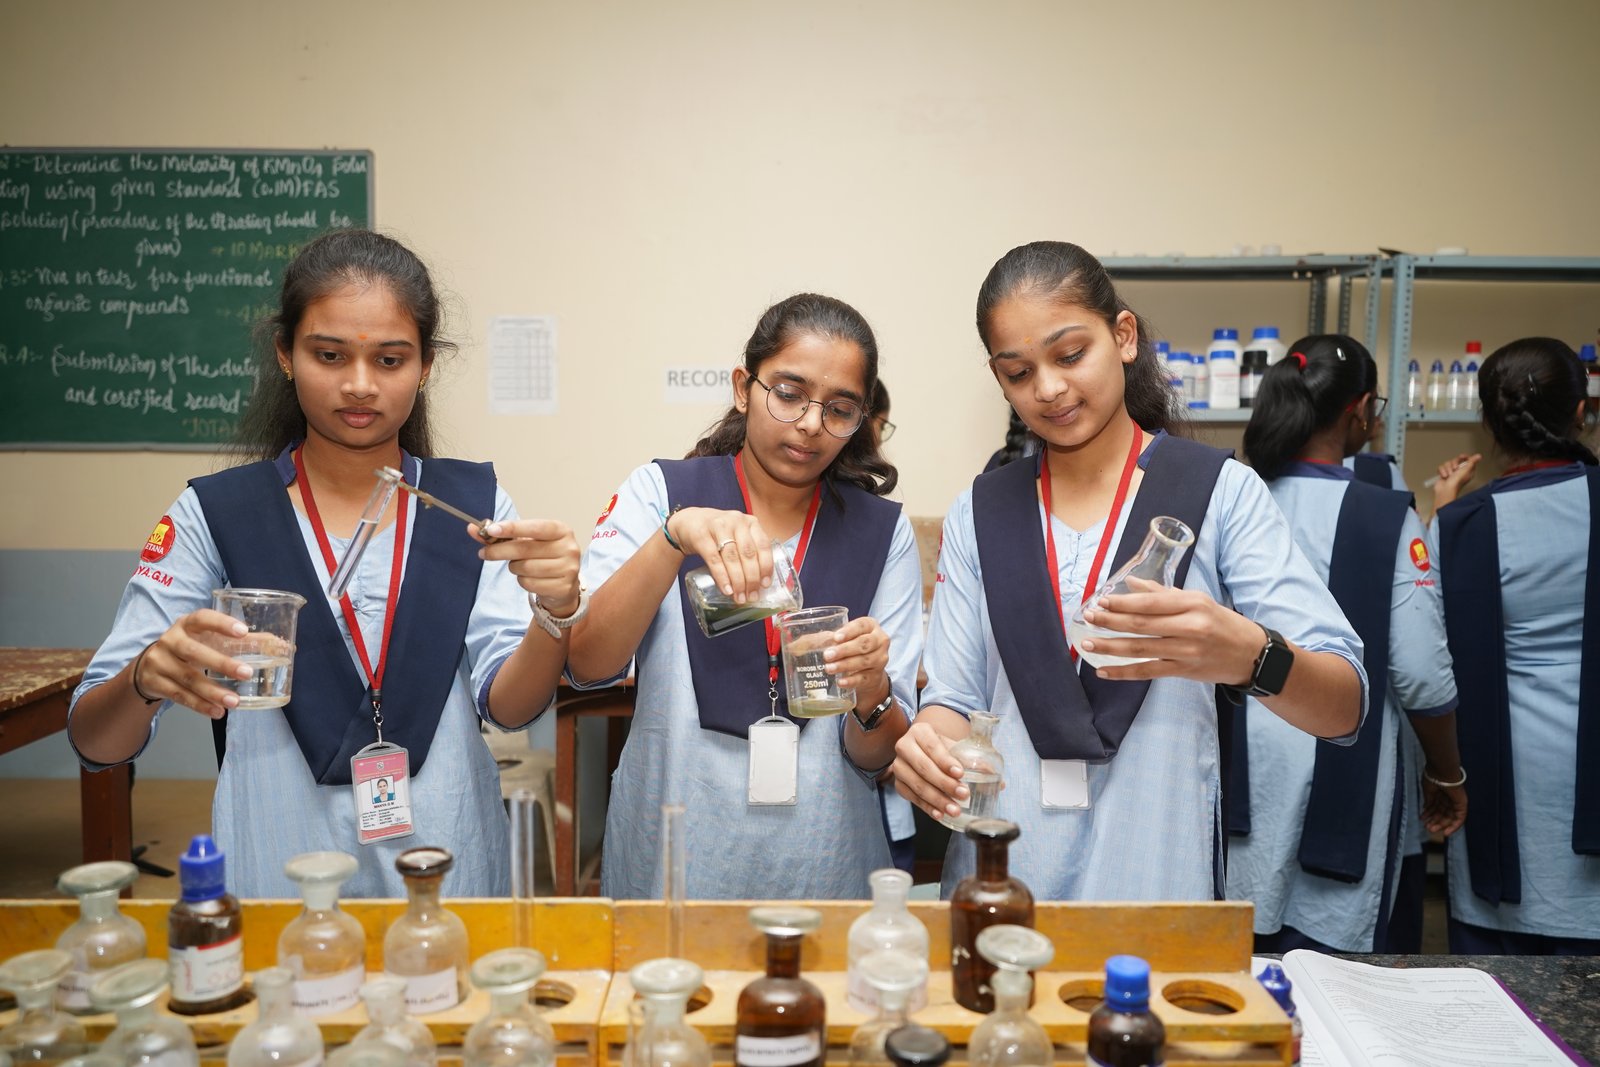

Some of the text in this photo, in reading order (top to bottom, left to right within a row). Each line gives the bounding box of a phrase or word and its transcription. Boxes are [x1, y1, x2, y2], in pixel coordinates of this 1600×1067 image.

[130, 153, 158, 171] the
[162, 155, 236, 183] Molarity
[242, 156, 260, 178] of
[44, 178, 97, 215] using
[110, 176, 155, 212] given
[166, 213, 180, 236] of
[185, 211, 208, 230] the
[330, 210, 352, 228] be
[231, 241, 246, 257] 10
[148, 266, 178, 291] for
[183, 267, 273, 293] functional
[25, 292, 190, 330] organic compounds
[51, 343, 156, 382] Submission
[160, 352, 177, 384] of
[667, 370, 730, 387] RECOR
[64, 385, 98, 406] and
[803, 678, 829, 689] 250ml
